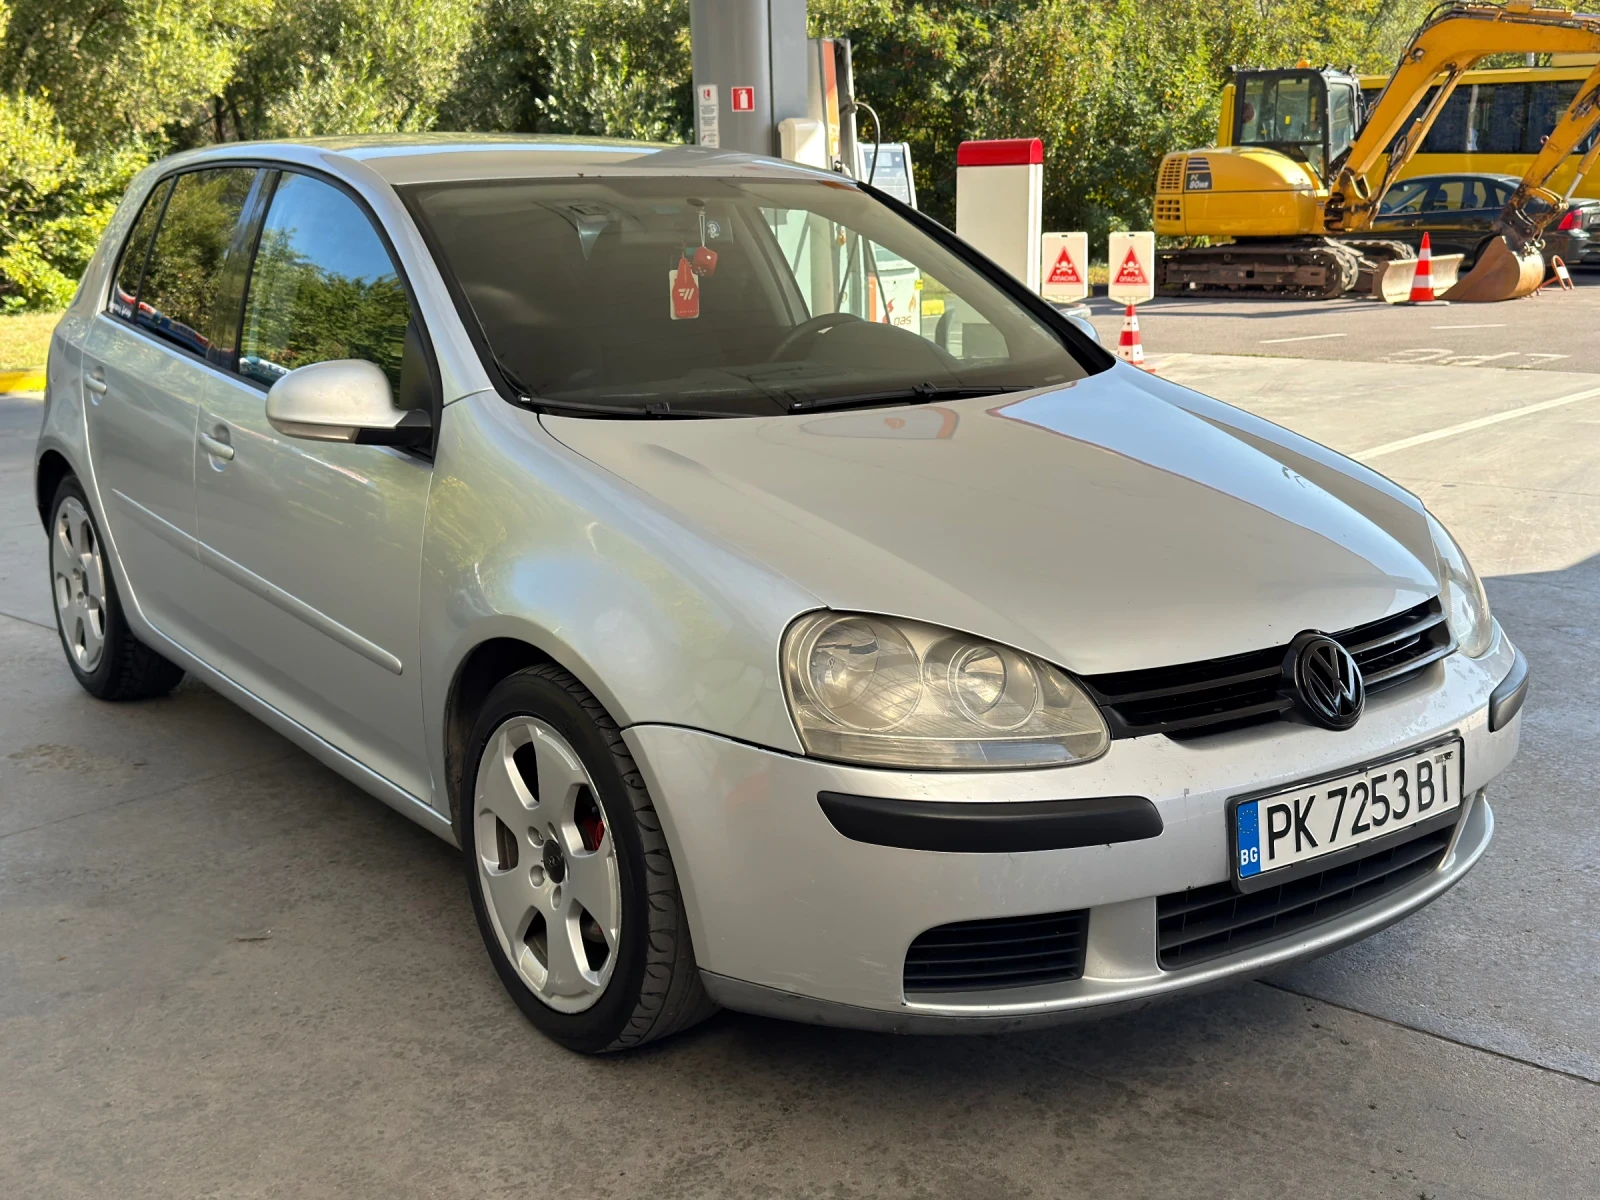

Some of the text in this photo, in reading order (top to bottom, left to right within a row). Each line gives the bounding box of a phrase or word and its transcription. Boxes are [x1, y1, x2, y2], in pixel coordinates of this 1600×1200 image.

[1119, 275, 1143, 283] ОПАСНО
[1267, 750, 1454, 860] PK 7253 BT
[1240, 847, 1258, 866] BG
